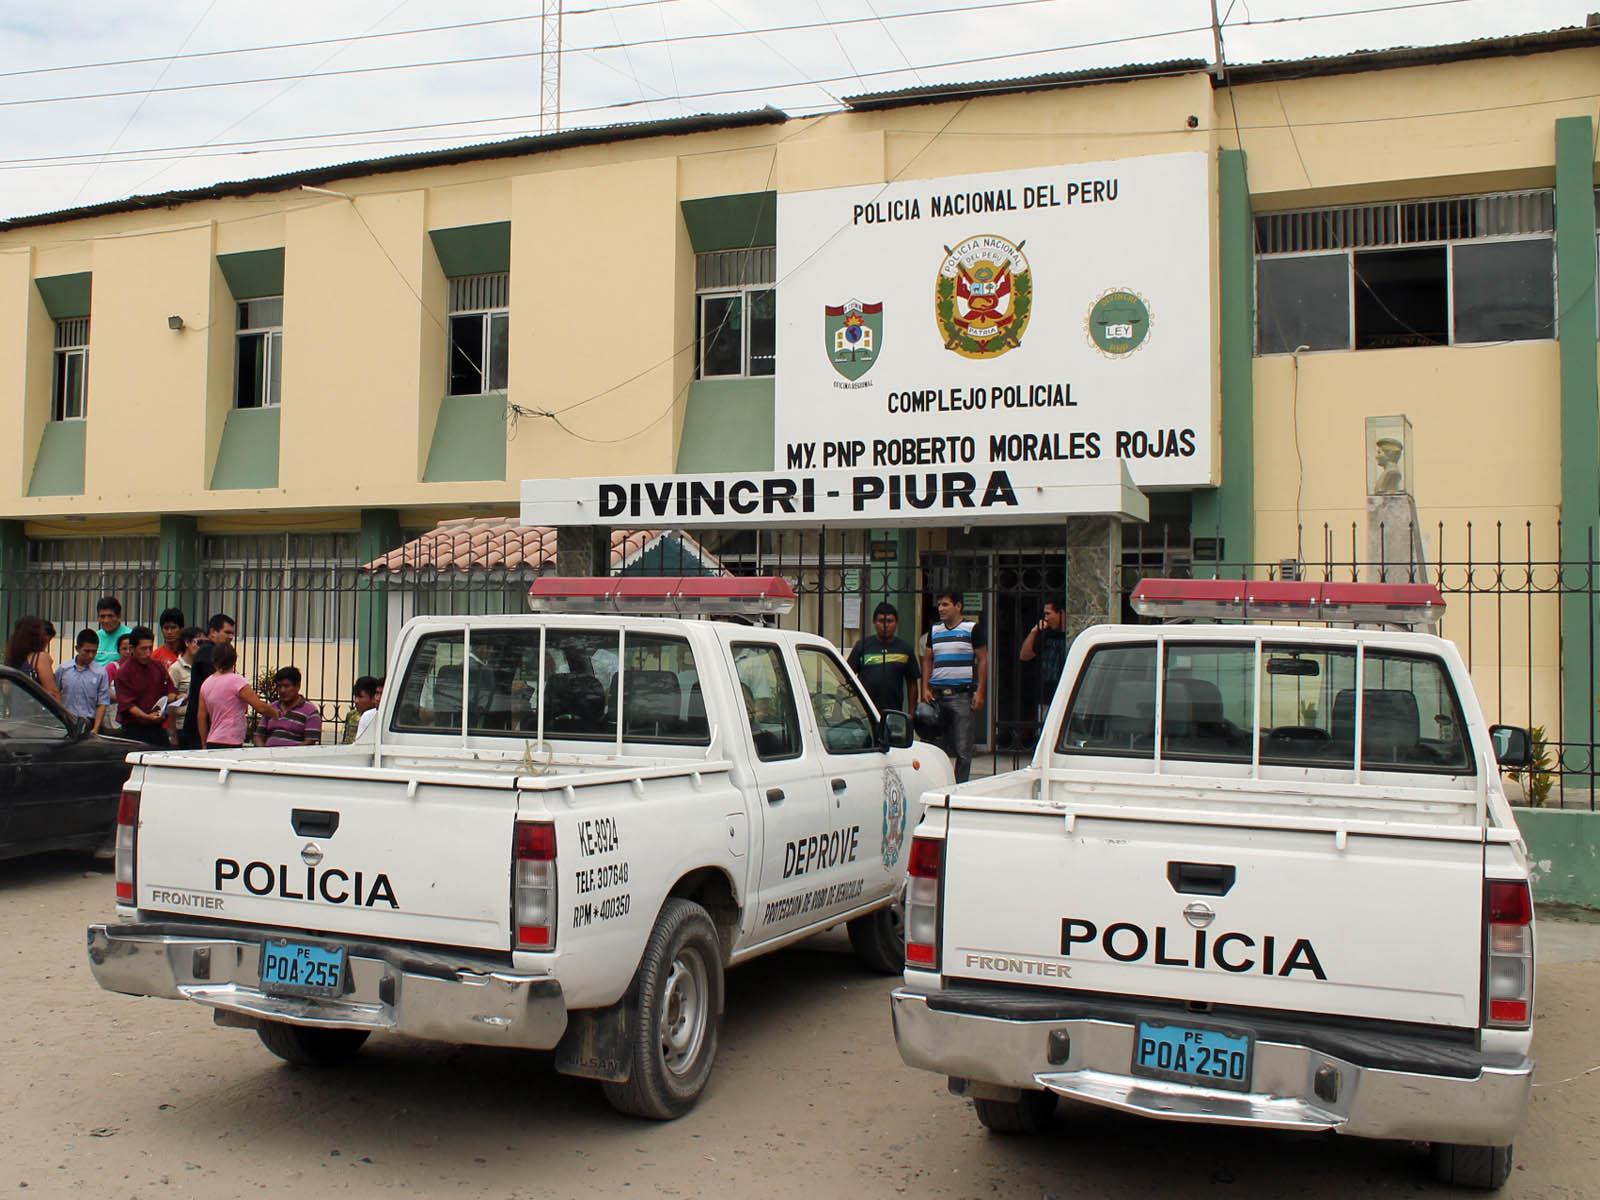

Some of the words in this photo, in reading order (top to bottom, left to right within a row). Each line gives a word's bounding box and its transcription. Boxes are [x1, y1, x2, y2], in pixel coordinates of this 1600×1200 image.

[853, 198, 921, 226] POLICIA
[931, 189, 1017, 218] NACIONAL
[1023, 186, 1061, 209] DEL
[1067, 179, 1118, 205] PERU
[944, 240, 980, 272] POLICIA
[983, 238, 1021, 266] NACIONAL
[966, 254, 980, 263] DEL
[982, 251, 1003, 262] PERU
[968, 327, 997, 336] PATRIA
[1107, 326, 1130, 336] LEY
[887, 388, 987, 414] COMPLEJO
[991, 383, 1078, 409] POLICIAL
[787, 441, 817, 470] MY.
[823, 440, 866, 469] PNP
[872, 435, 976, 467] ROBERTO
[989, 431, 1101, 463] MORALES
[1116, 428, 1196, 459] ROJAS
[598, 478, 815, 518] DIVINCRI
[852, 470, 1019, 512] PIURA
[577, 817, 619, 857] KE-8924
[782, 825, 860, 880] DEPROVE
[215, 858, 400, 909] POLICIA
[575, 868, 596, 894] TELF.
[597, 862, 629, 890] 307648
[152, 889, 224, 911] FRONTIER
[573, 903, 592, 928] RPM
[297, 947, 310, 959] PE
[1060, 917, 1328, 981] POLICIA
[265, 954, 339, 987] POA-255
[965, 953, 1072, 979] FRONTIER
[1184, 1031, 1203, 1044] PE
[1140, 1038, 1245, 1080] POA-250
